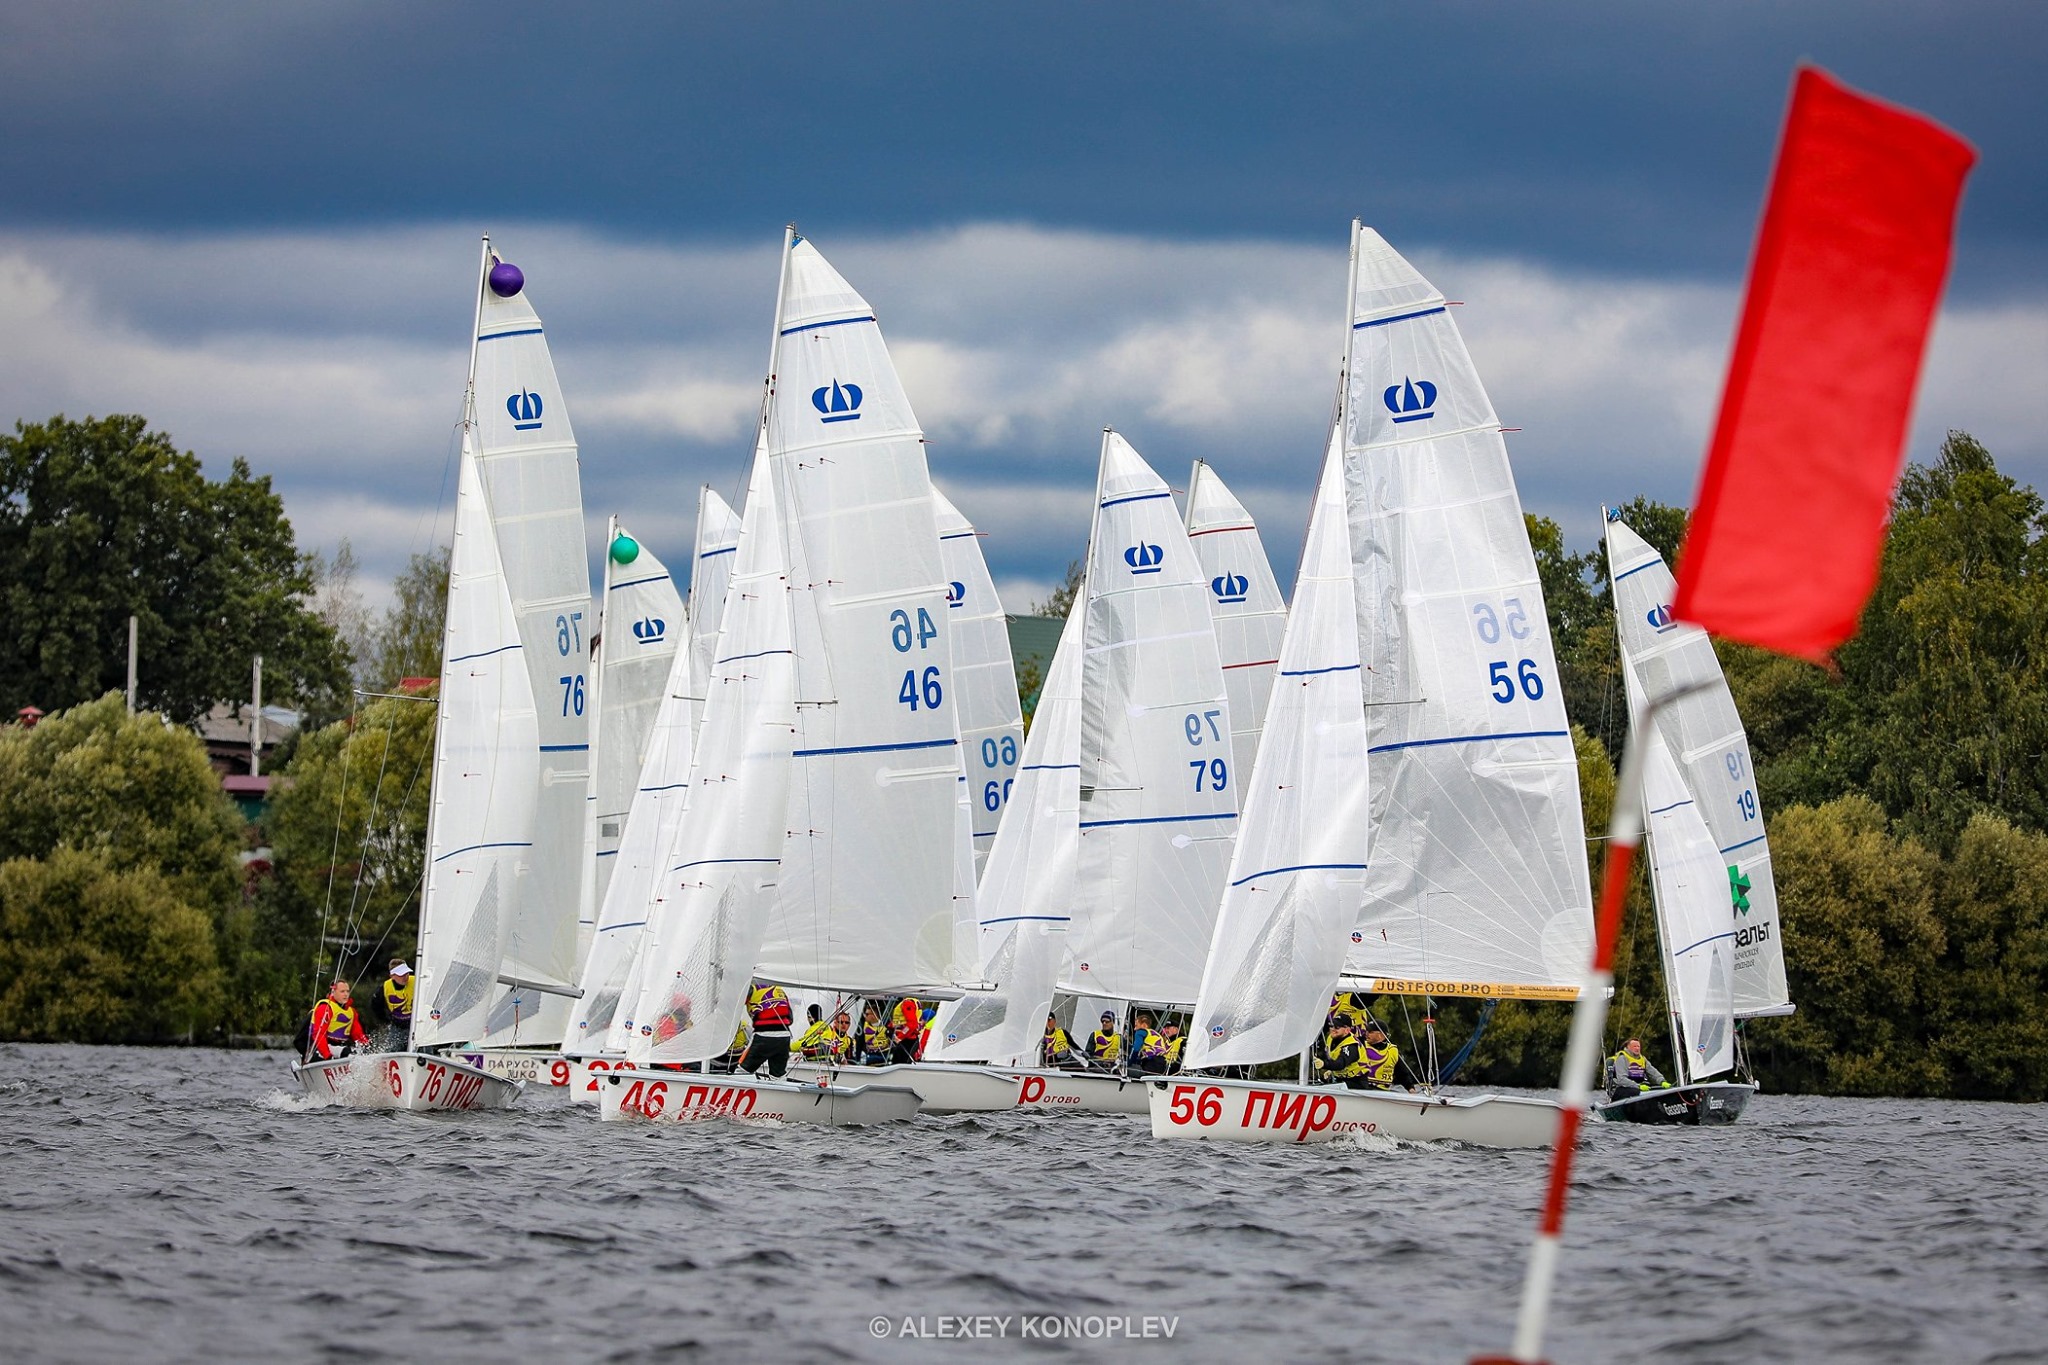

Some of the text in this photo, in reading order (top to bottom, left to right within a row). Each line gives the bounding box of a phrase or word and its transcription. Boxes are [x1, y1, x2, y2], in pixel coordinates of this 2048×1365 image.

[560, 675, 584, 716] 76
[898, 666, 942, 711] 46
[1489, 658, 1544, 704] 56
[1189, 758, 1228, 793] 79
[1736, 789, 1756, 822] 19
[1377, 981, 1491, 995] JUSTFOOD.PRO
[419, 1063, 446, 1102] 76
[619, 1081, 668, 1119] 46
[1169, 1085, 1224, 1126] 56
